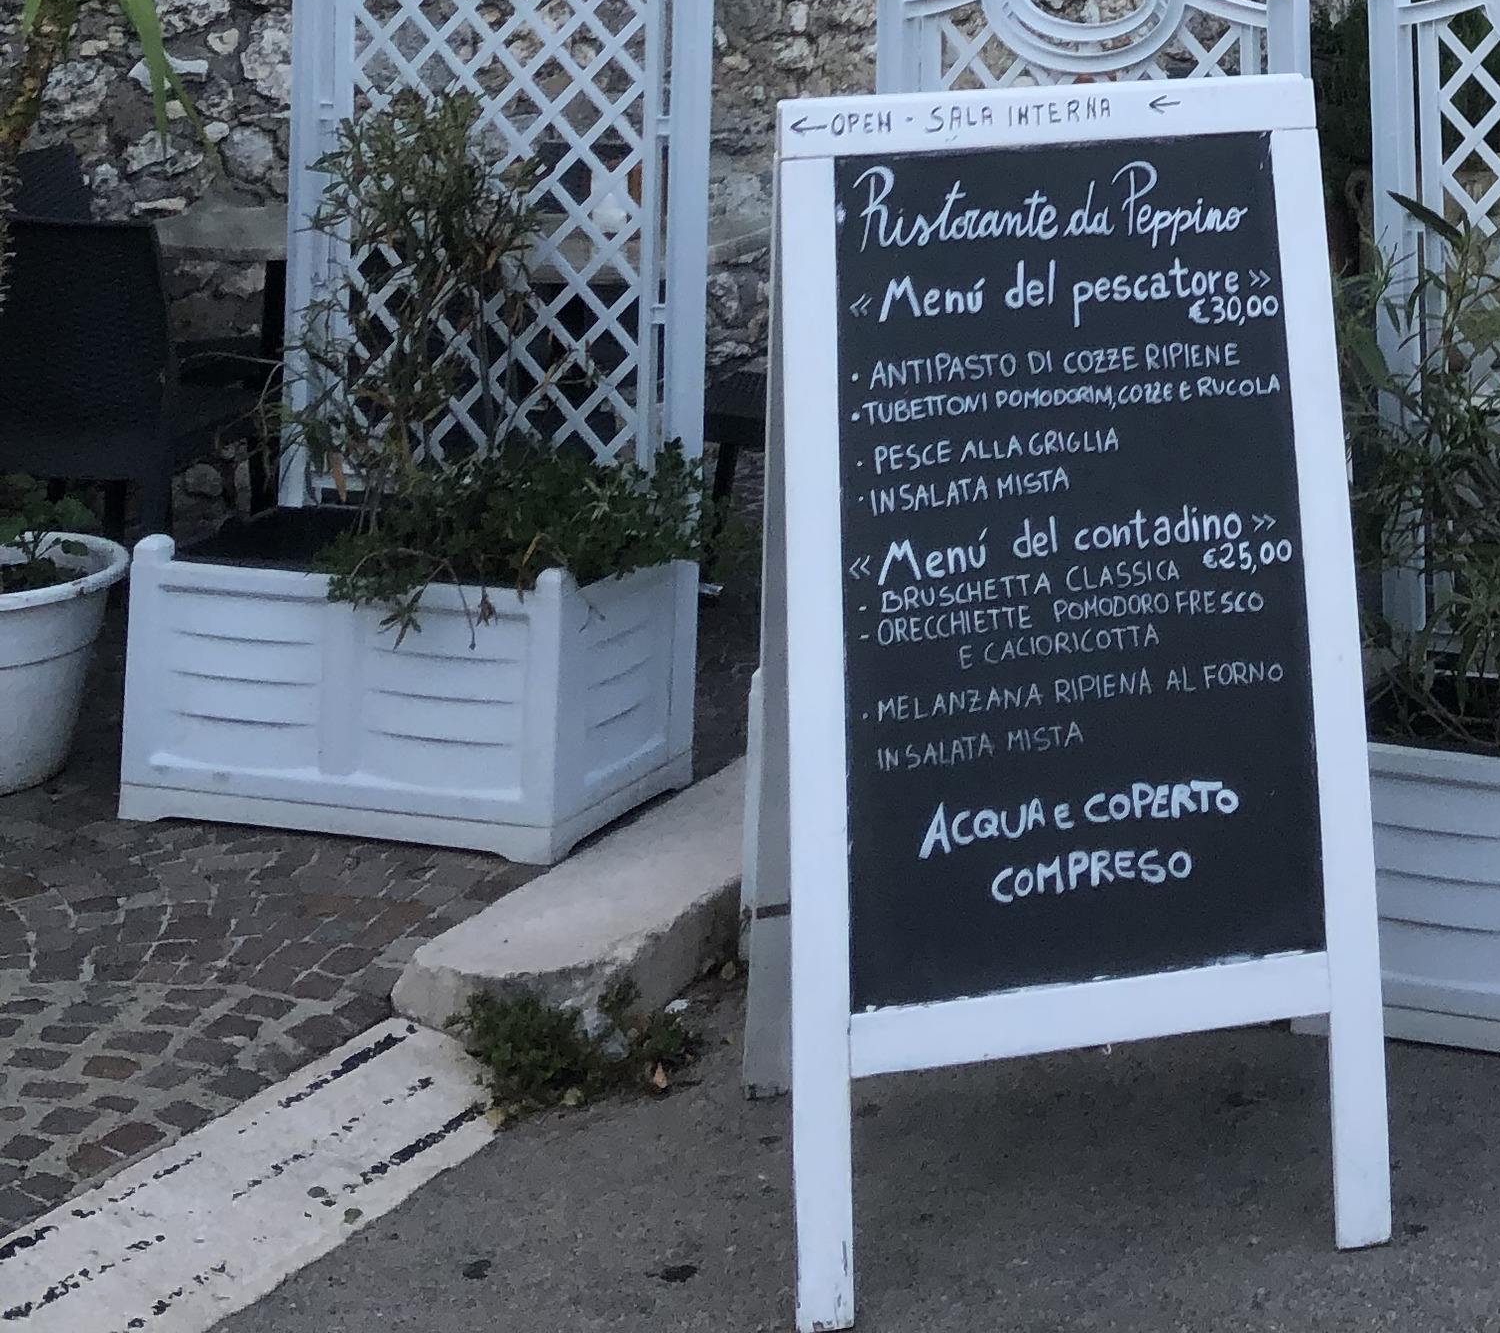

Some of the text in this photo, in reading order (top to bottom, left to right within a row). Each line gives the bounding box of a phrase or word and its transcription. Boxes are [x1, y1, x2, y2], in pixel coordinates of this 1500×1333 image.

[830, 110, 893, 137] OPEN
[925, 105, 993, 134] SALA
[1008, 96, 1111, 127] INTERNA
[852, 161, 1248, 254] Ristorante da Peppino
[1005, 259, 1057, 309] del
[1073, 257, 1239, 328] pescatore
[1188, 295, 1279, 326] €30,00
[869, 342, 1240, 390] ANTIPASTO DI COZZE RIPIENE
[862, 392, 987, 425] TUBETTONI
[1197, 374, 1281, 397] RUCOLA
[874, 427, 1119, 474] PESCE ALLA GRIGLIA
[870, 466, 1070, 516] INSALATA MISTA
[1013, 516, 1058, 558] del
[1074, 504, 1242, 551] contadino
[1202, 539, 1293, 575] €25,00
[881, 559, 1181, 613] BRUSCHETTA CLASSICA
[877, 589, 1264, 646] ORECCHIETTE POMODORO FRESCO
[959, 623, 1160, 669] E CACIORICOTTA
[877, 661, 1284, 722] MELANZANA RIPIENA AL FORNO
[877, 720, 1084, 772] INSALATA MISTA
[918, 797, 1046, 859] ACQUA
[1083, 779, 1240, 823] COPERTO
[991, 849, 1193, 903] COMPRESO
